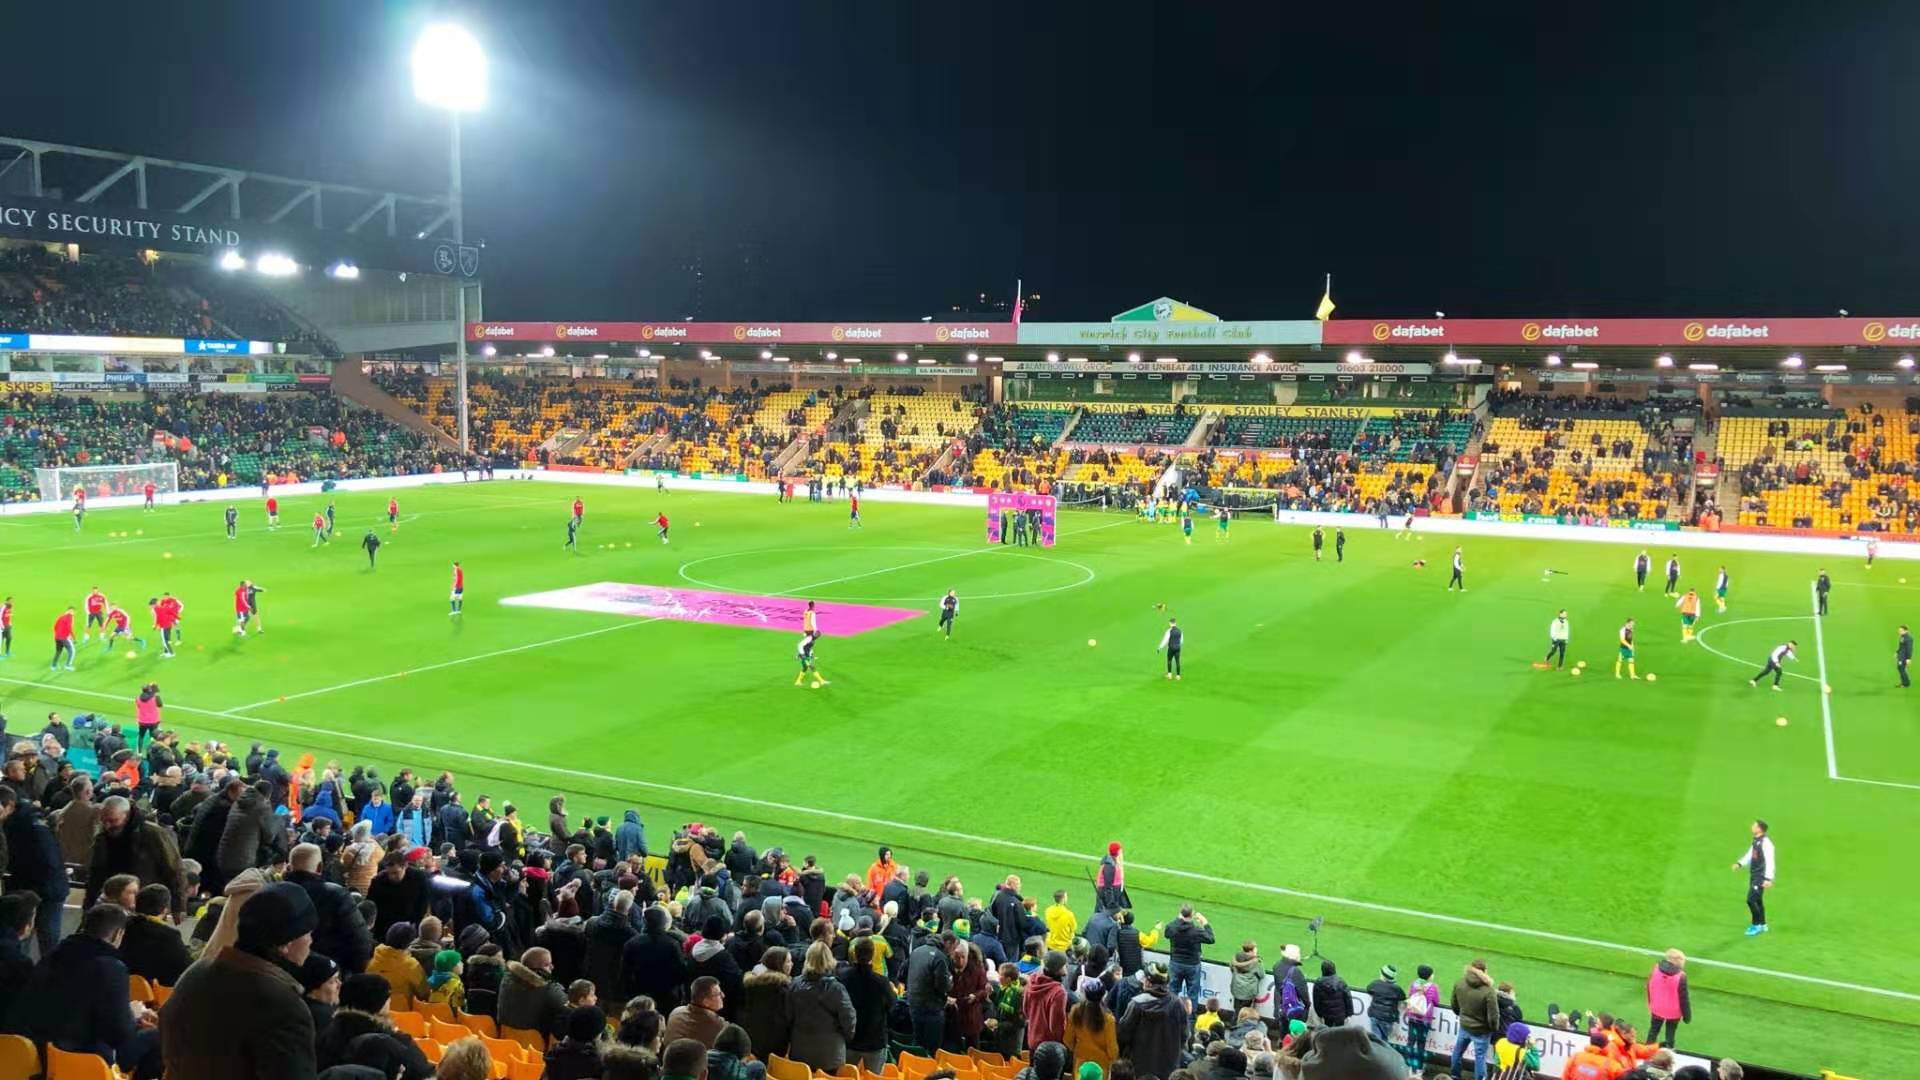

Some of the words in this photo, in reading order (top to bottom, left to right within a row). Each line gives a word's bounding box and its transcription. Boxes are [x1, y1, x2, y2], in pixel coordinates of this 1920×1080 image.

[0, 207, 37, 227] CY
[48, 211, 161, 239] SECURITY
[171, 224, 240, 246] STAND
[485, 326, 514, 336] dafabet
[567, 326, 598, 336] dafabet
[654, 326, 687, 337] dafabet
[746, 327, 781, 338] dafabet
[845, 327, 882, 338] dafabet
[950, 327, 989, 338] dafabet
[1392, 325, 1444, 338] dafabet
[1542, 325, 1599, 338] dafabet
[1706, 325, 1769, 338] dafabet
[1208, 363, 1261, 372] INSURANCE
[6, 382, 44, 392] SKIPS
[1021, 403, 1070, 411] STANLEY
[1151, 405, 1203, 415] STAEY
[1235, 406, 1291, 417] STANLEY
[1305, 407, 1364, 418] STANLEY
[1535, 1034, 1576, 1057] ght
